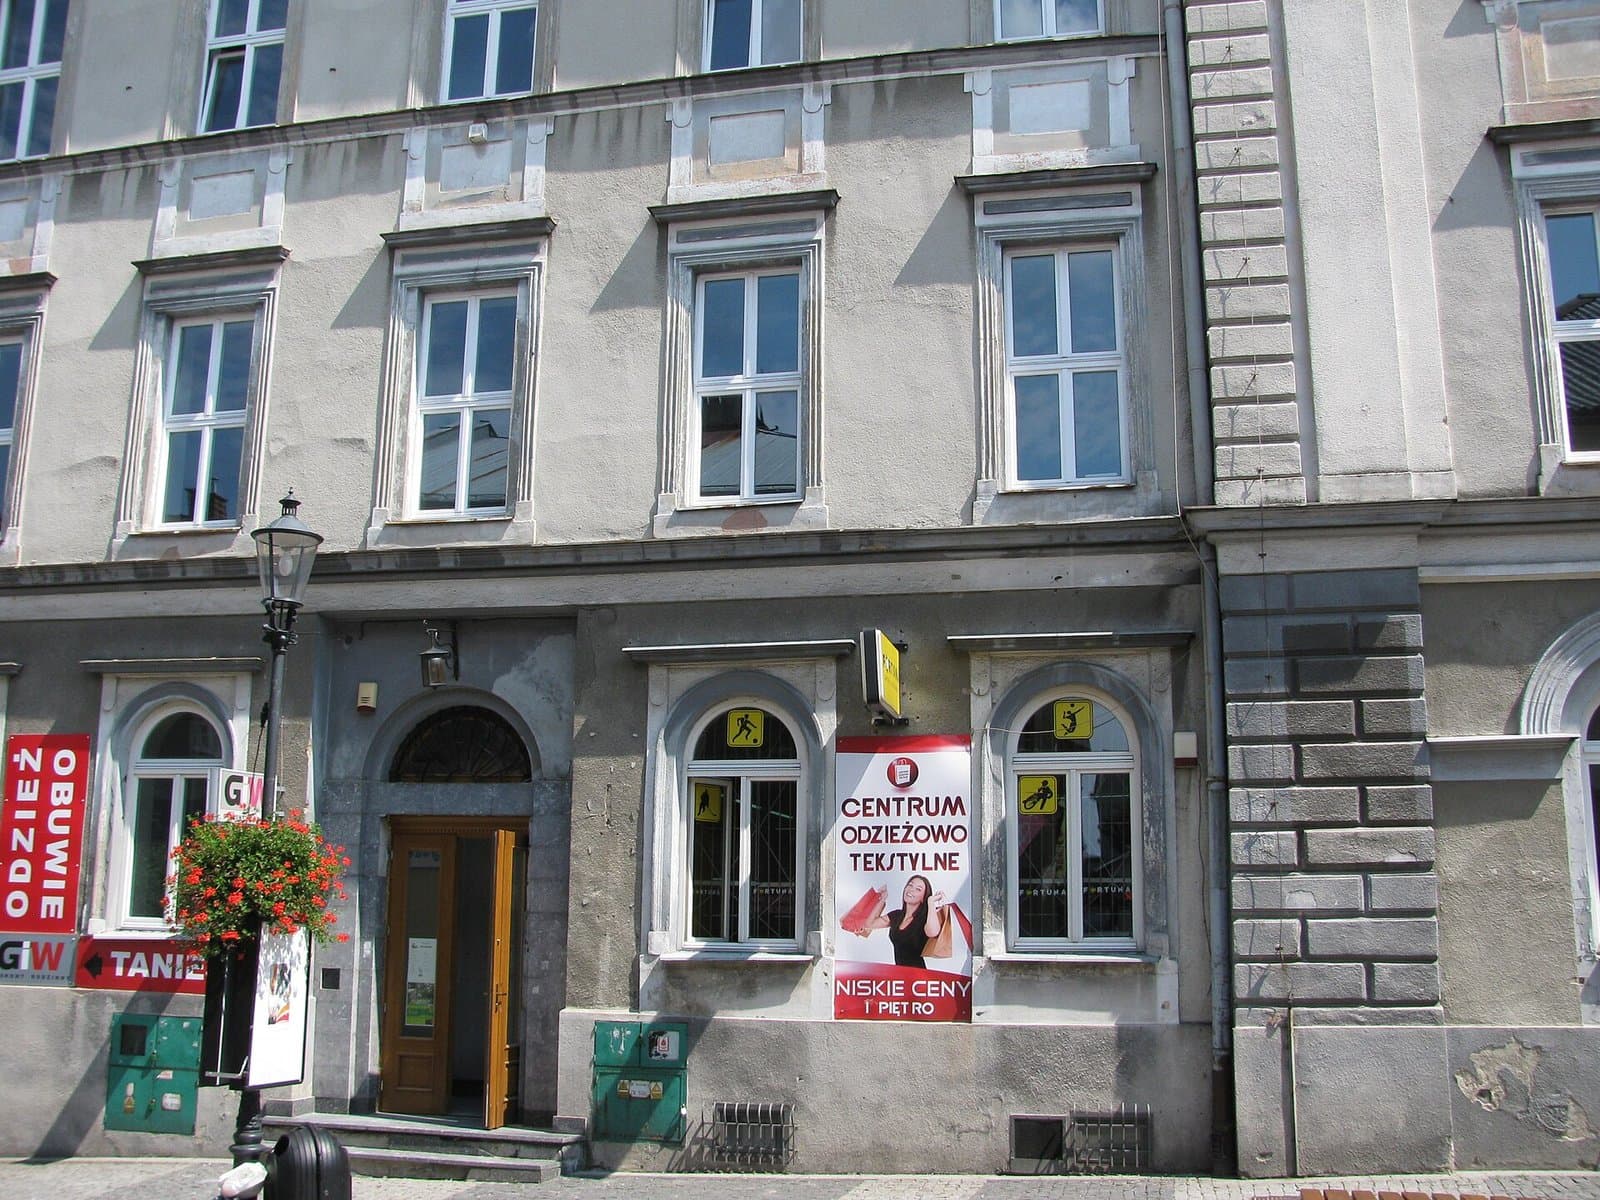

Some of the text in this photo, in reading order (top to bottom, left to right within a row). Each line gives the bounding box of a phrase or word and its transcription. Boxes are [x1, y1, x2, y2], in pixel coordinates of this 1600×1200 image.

[841, 796, 966, 818] CENTRUM
[5, 748, 43, 918] ODZIEŻ
[40, 749, 76, 919] OBUWIE
[841, 821, 968, 844] ODZIEŻOWO
[849, 852, 960, 872] TEKSTYLNE
[0, 941, 64, 971] GiW
[110, 951, 205, 980] TANIE
[836, 979, 971, 997] NISKIE CENY
